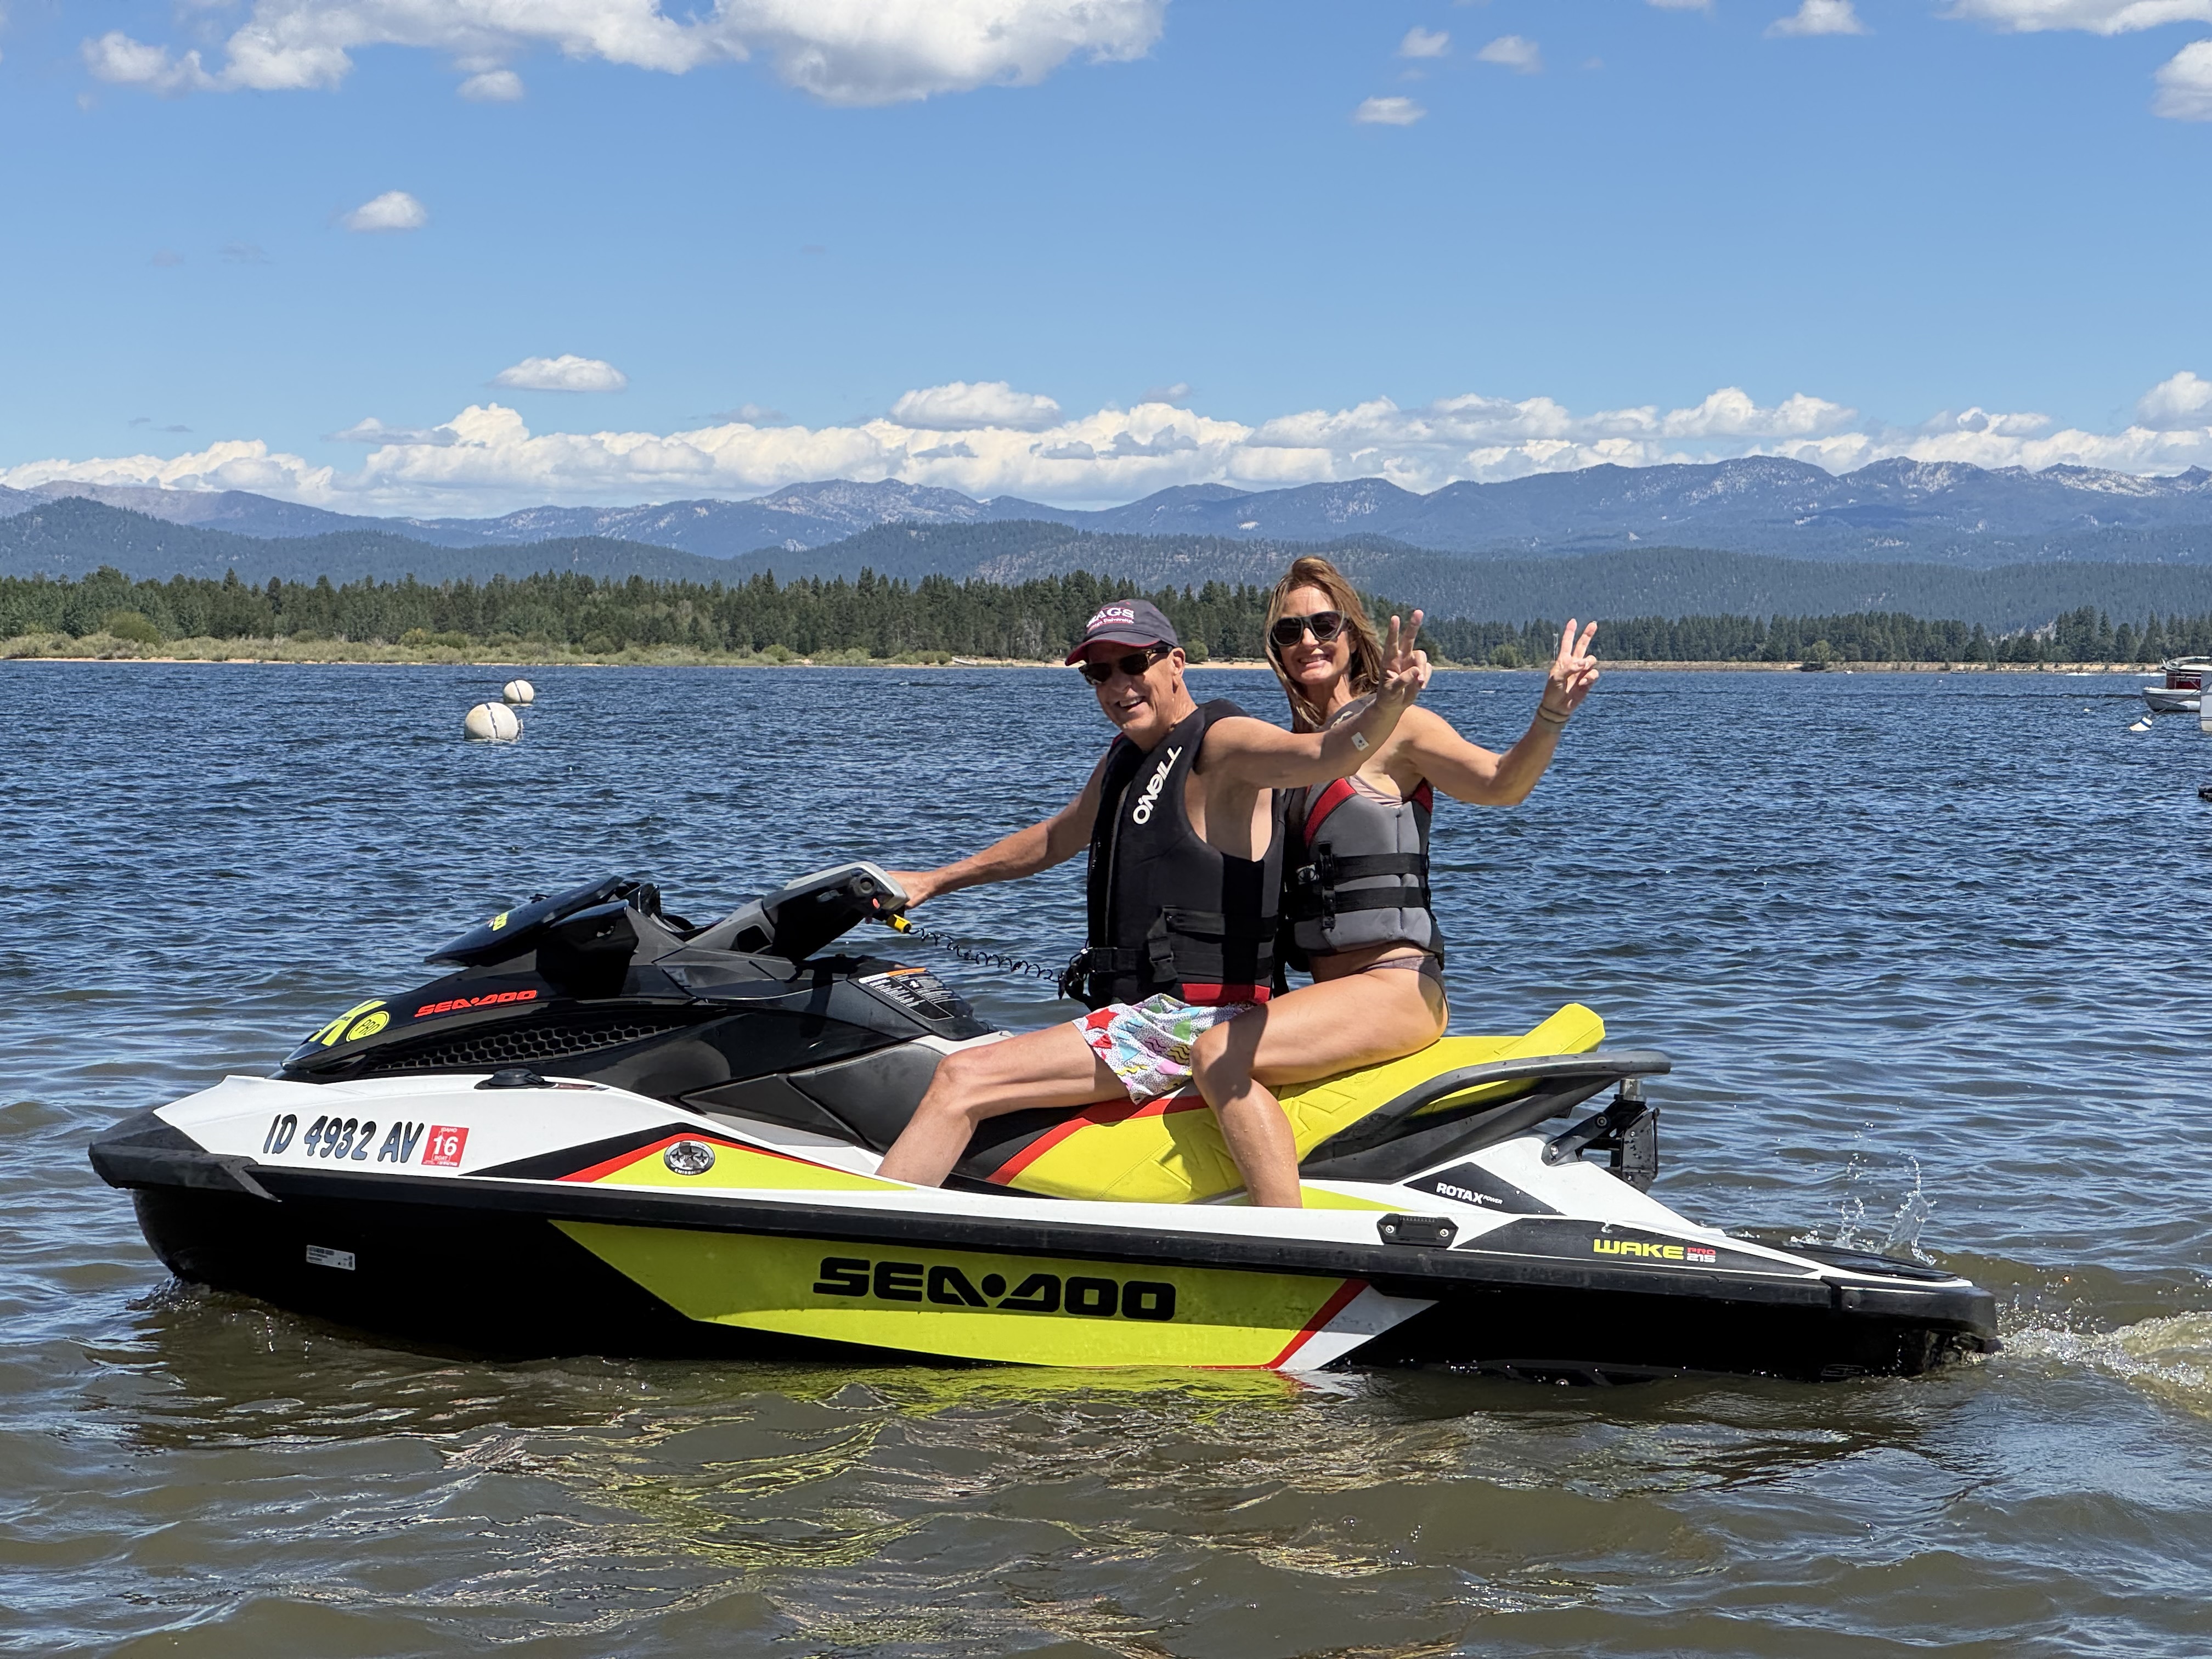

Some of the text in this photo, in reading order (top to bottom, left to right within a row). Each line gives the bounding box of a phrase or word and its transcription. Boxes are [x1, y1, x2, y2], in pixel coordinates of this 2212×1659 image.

[355, 1019, 380, 1035] PRO
[263, 1114, 424, 1163] ID 4932 AV
[433, 1136, 459, 1156] 16
[1436, 1182, 1503, 1204] ROTAX POWER
[1594, 1239, 1716, 1260] WAKE PRO
[1686, 1253, 1716, 1263] 215
